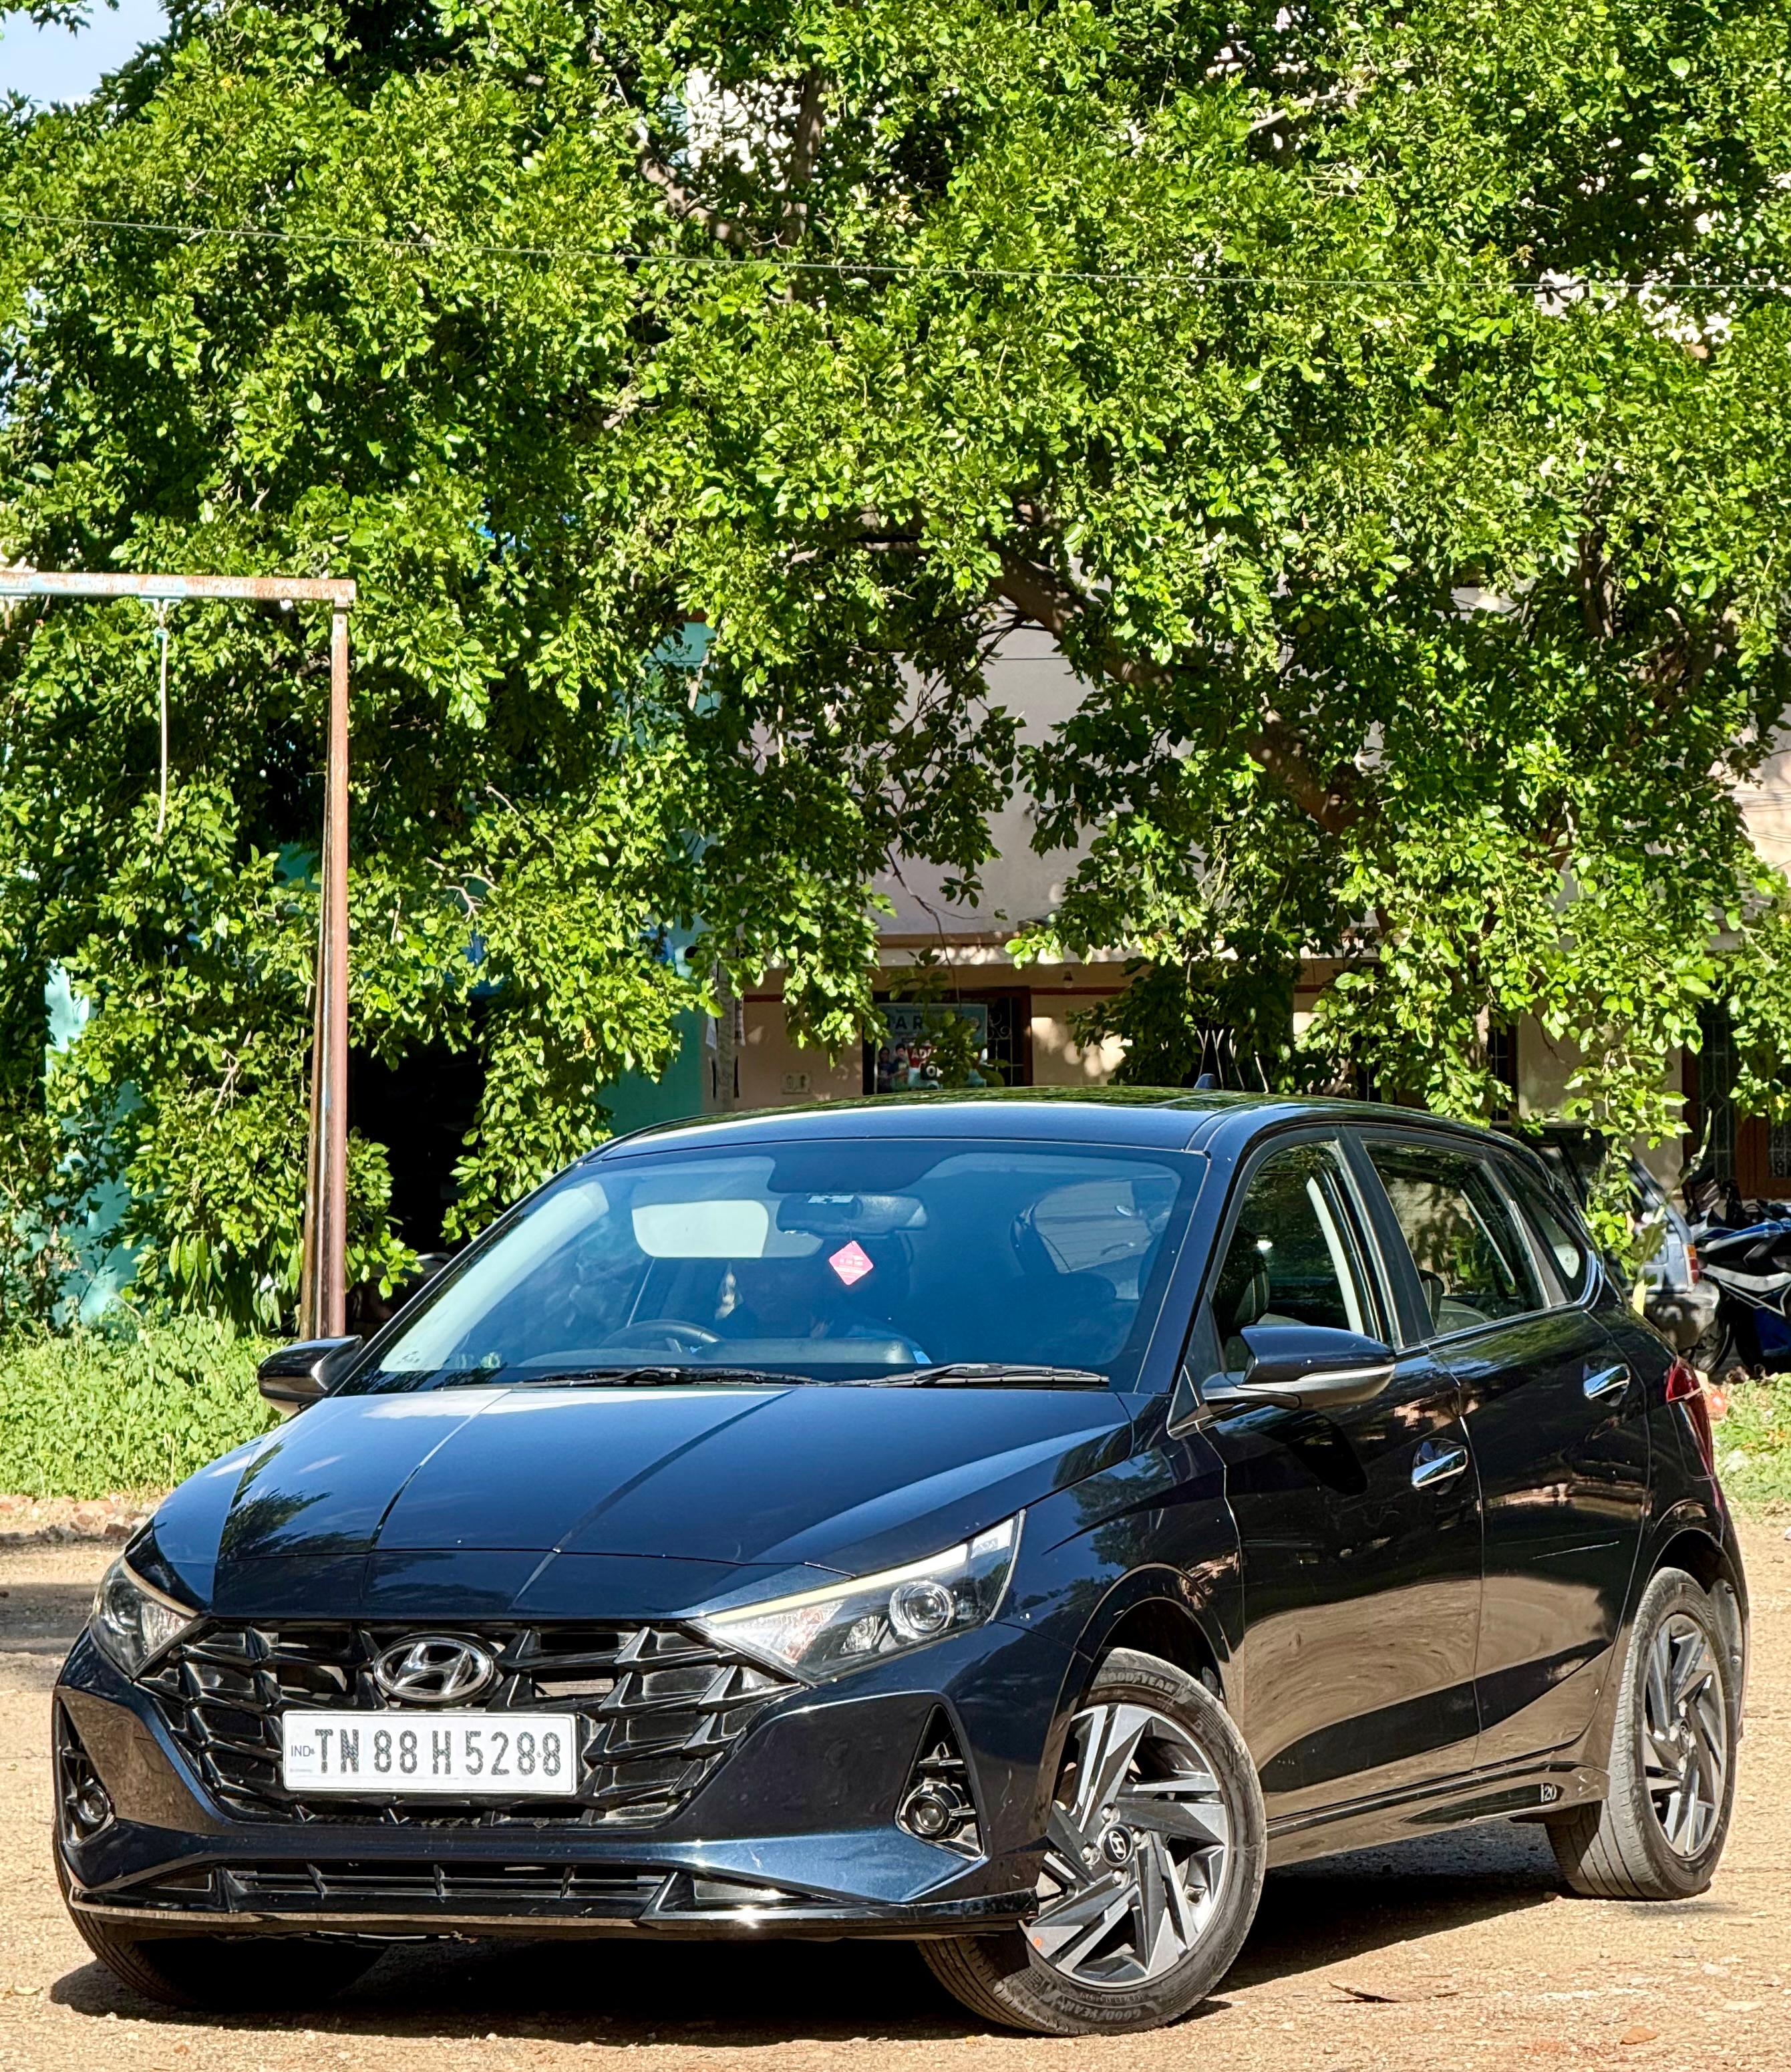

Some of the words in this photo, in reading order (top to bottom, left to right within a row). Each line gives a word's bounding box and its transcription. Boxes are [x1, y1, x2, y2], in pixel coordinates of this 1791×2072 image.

[291, 1745, 311, 1757] IND
[315, 1729, 359, 1774] TN
[374, 1729, 418, 1774] 88
[432, 1730, 452, 1775] H
[466, 1730, 561, 1777] 5288
